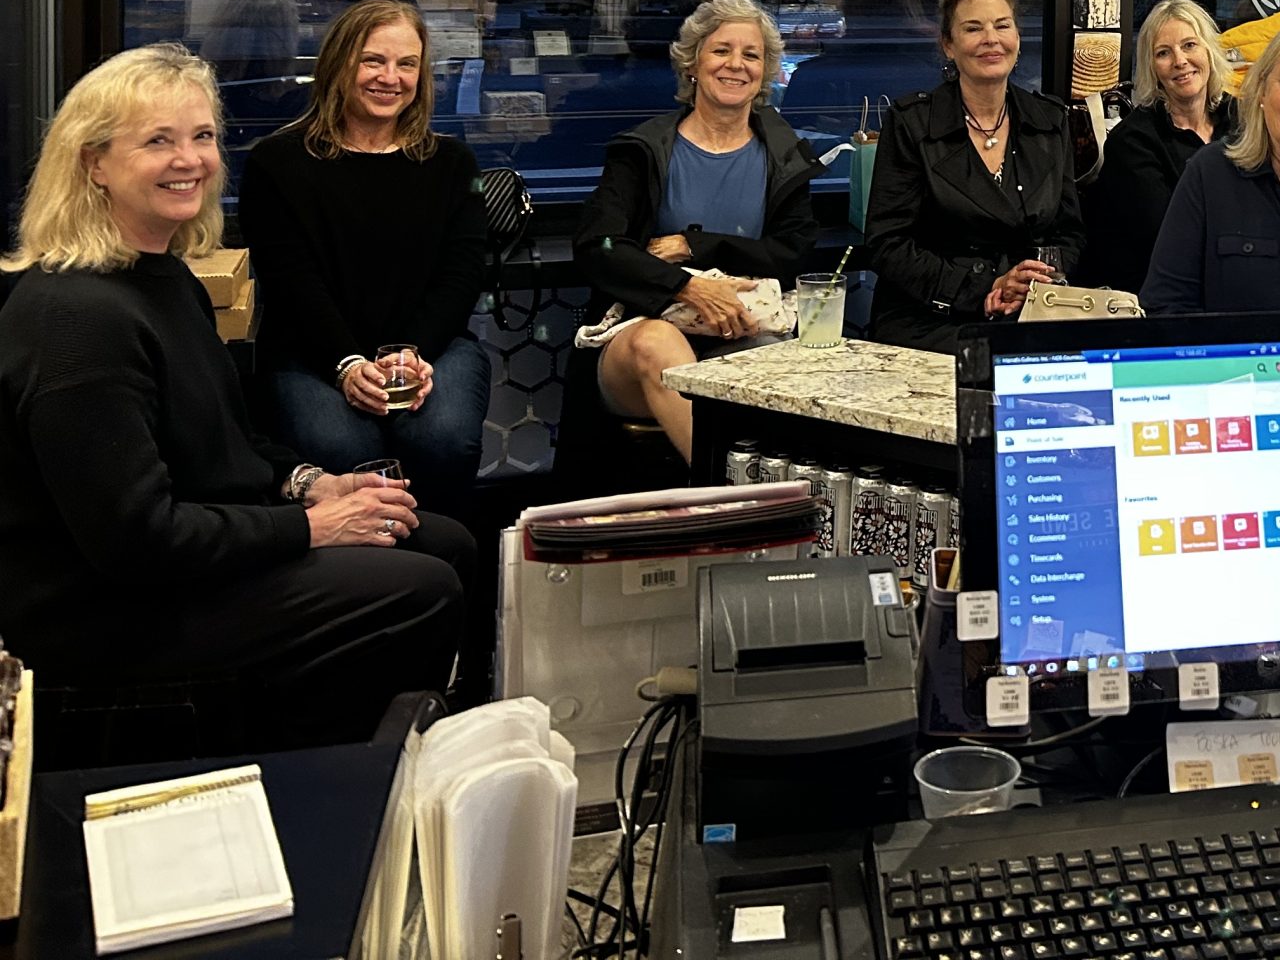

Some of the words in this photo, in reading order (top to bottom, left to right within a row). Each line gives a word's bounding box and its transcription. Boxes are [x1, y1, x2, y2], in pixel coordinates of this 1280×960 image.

[1034, 372, 1087, 383] counterpoint
[1119, 395, 1150, 403] Recently
[1152, 394, 1170, 402] Used
[1027, 417, 1047, 426] Home
[1026, 455, 1057, 465] Inventory
[1027, 474, 1061, 483] Customers
[1028, 494, 1063, 505] Purchasing
[1028, 514, 1044, 523] Sales
[1045, 513, 1070, 524] History
[1029, 534, 1066, 543] Ecommerce
[1030, 553, 1064, 562] Timecards
[1030, 574, 1047, 583] Data
[1047, 572, 1085, 583] Interchange
[1031, 594, 1055, 604] System
[1032, 615, 1052, 625] Setup
